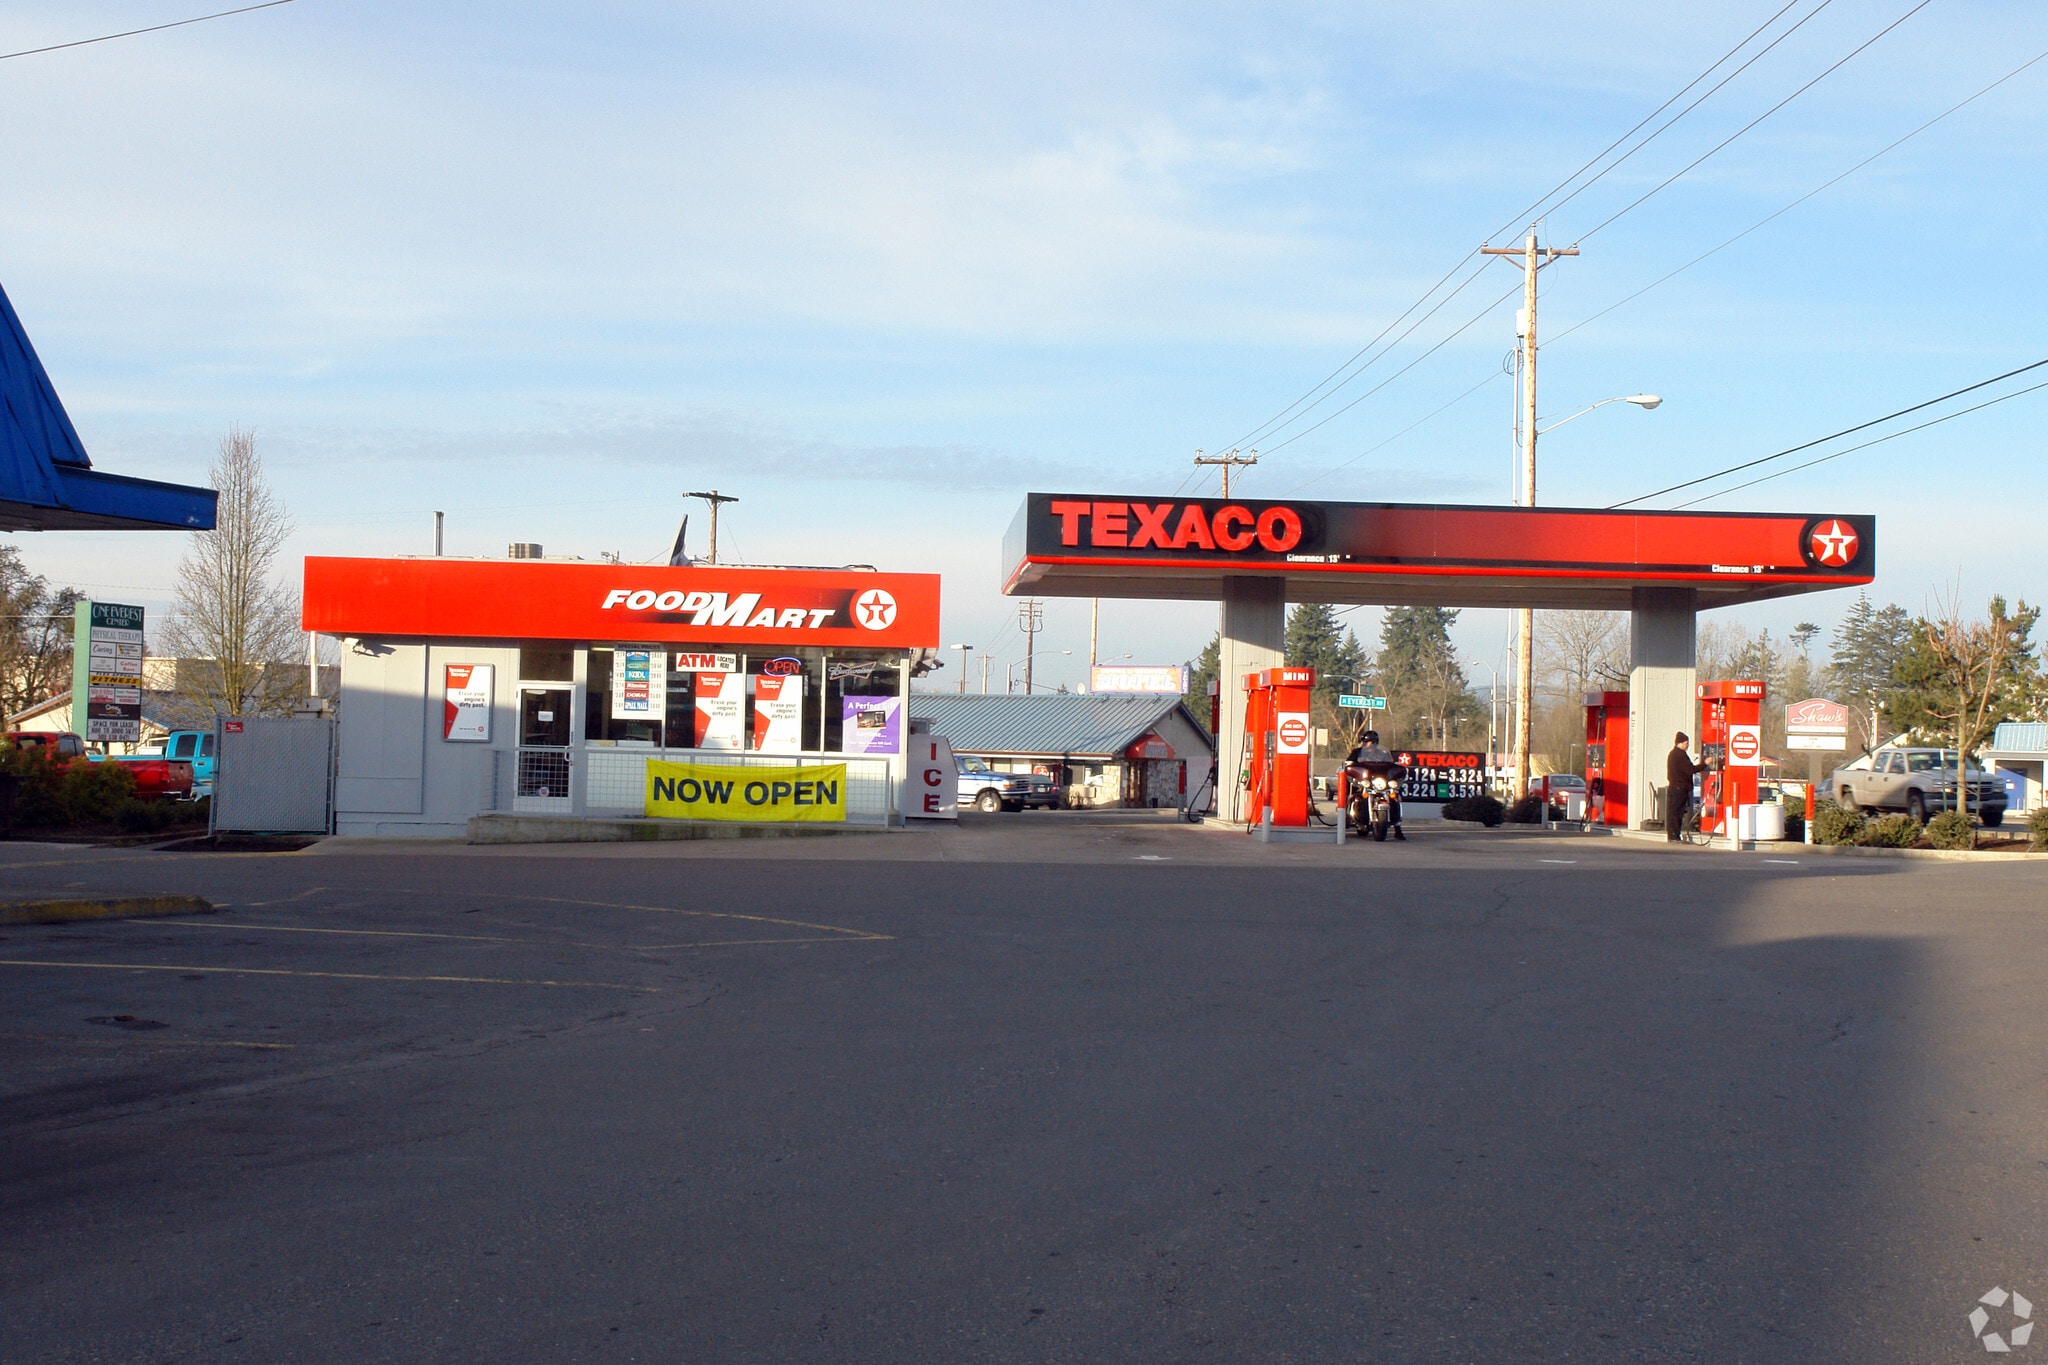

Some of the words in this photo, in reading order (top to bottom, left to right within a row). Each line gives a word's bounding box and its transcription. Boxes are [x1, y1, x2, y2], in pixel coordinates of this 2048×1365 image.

[1051, 501, 1302, 552] TEXACO
[1287, 554, 1325, 563] Clearance
[1711, 564, 1749, 573] Clearance
[111, 606, 143, 622] EVEREST
[106, 617, 129, 626] CENTER
[92, 629, 116, 640] PHYSICAL
[118, 631, 140, 642] THERAPY
[678, 654, 716, 668] ATM
[717, 655, 735, 664] LOCATED
[763, 660, 800, 674] OPEN
[91, 675, 138, 684] FITNESS
[1283, 672, 1309, 681] MINI
[1735, 685, 1762, 694] MINI
[848, 701, 854, 709] A
[855, 701, 881, 710] Perfect
[882, 702, 896, 710] Gift
[1790, 703, 1844, 724] Shaw's
[1415, 753, 1479, 768] TEXACO
[923, 743, 942, 813] ICE
[1448, 768, 1476, 783] 3.32
[653, 777, 735, 804] NOW
[744, 780, 837, 805] OPEN
[1401, 783, 1429, 797] 3.22
